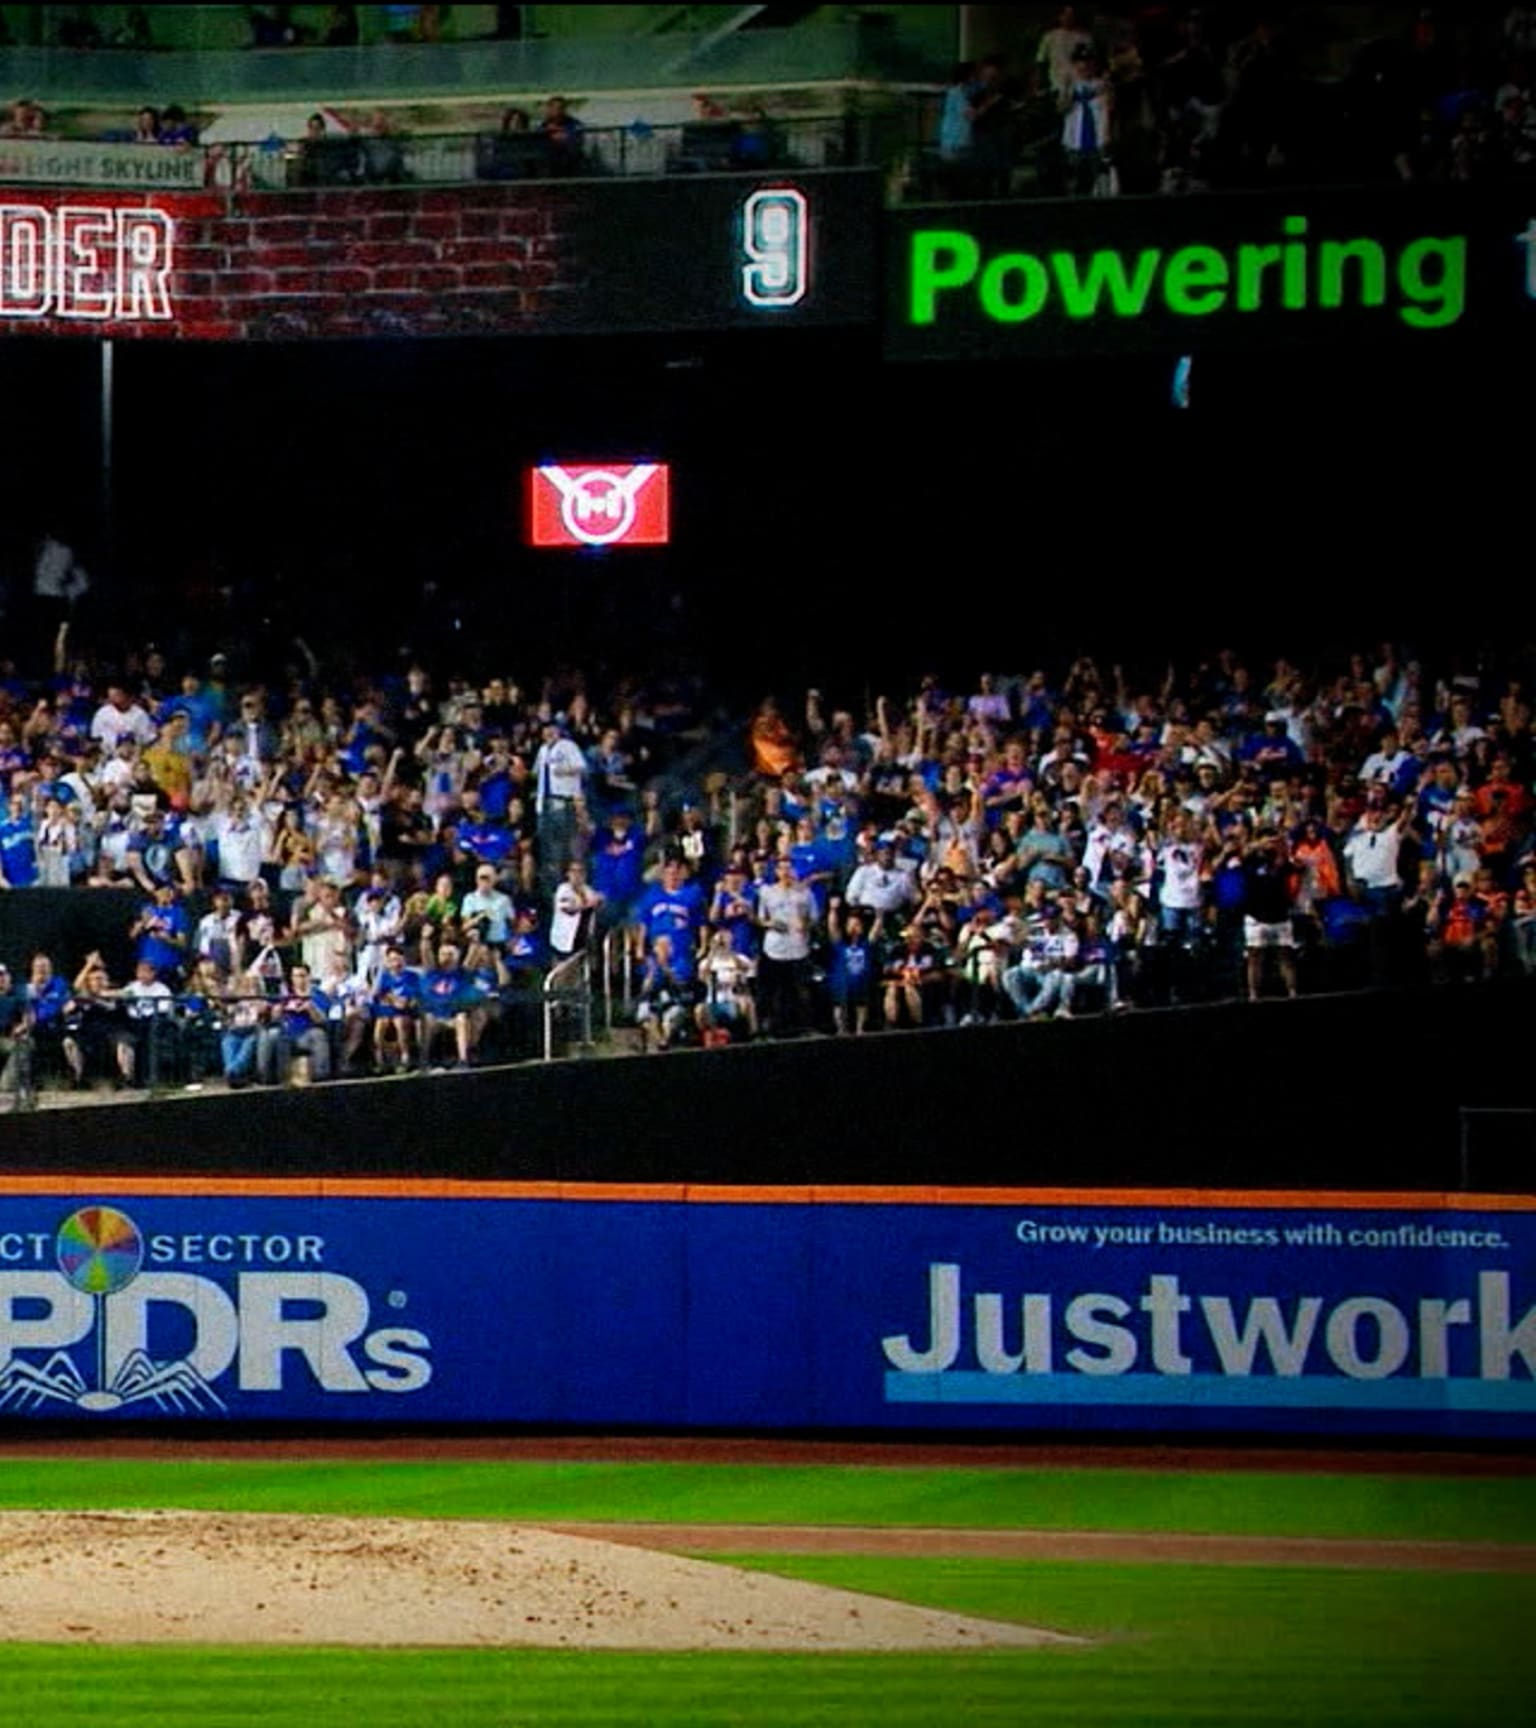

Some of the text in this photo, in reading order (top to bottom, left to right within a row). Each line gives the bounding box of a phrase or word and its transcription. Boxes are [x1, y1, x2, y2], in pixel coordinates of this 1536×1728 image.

[25, 153, 97, 178] LIGHT
[99, 157, 195, 181] SKYLINE
[743, 188, 809, 307] 9
[910, 216, 1466, 329] Powering
[150, 1235, 326, 1263] SECTOR
[1015, 1220, 1509, 1249] Grow your business with confidence.
[882, 1263, 1536, 1380] Justwork
